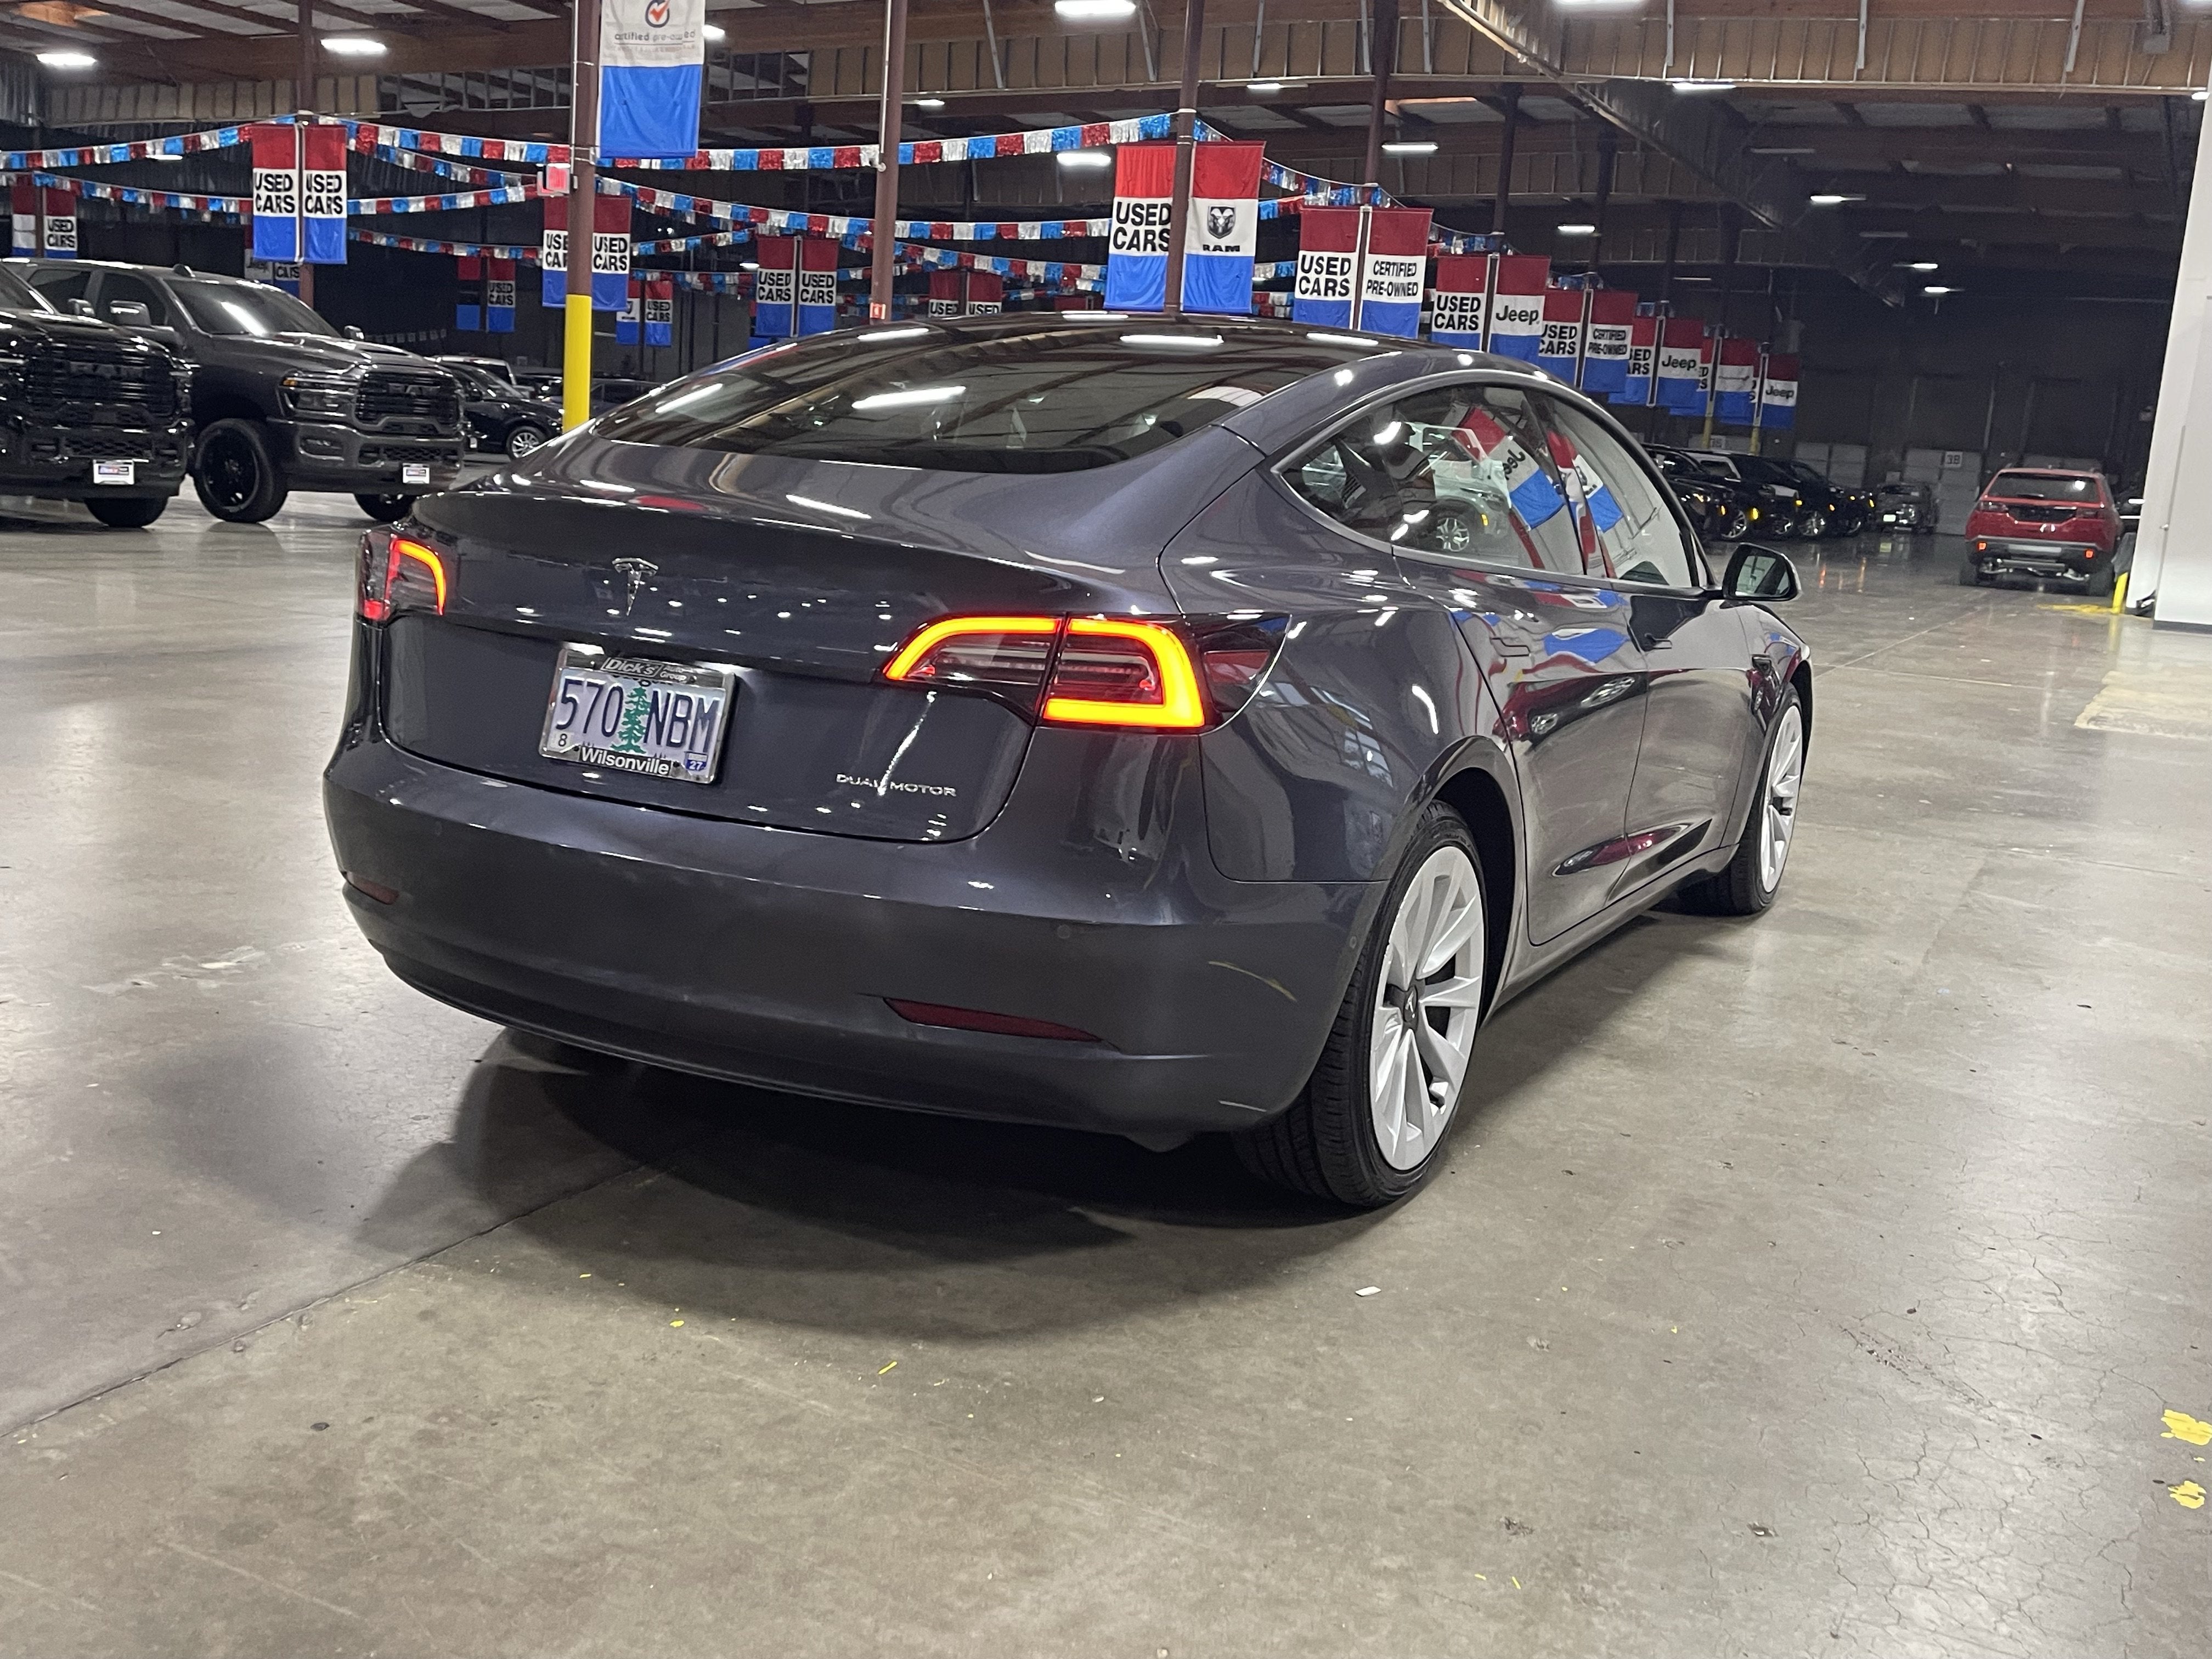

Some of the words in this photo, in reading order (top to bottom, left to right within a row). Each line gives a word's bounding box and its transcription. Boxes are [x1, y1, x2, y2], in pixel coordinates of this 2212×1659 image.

[254, 172, 293, 192] USED
[306, 173, 342, 193] USED
[255, 193, 295, 213] CARS
[305, 195, 343, 215] CARS
[1116, 201, 1172, 226] USED
[546, 234, 568, 250] USE
[595, 236, 628, 253] USED
[1113, 227, 1171, 251] CARS
[594, 254, 627, 271] CARS
[1300, 255, 1351, 276] USED
[1373, 260, 1417, 277] CERTIFIED
[759, 271, 791, 286] USED
[802, 273, 834, 288] USED
[1299, 275, 1350, 297] CARS
[758, 286, 791, 301] CARS
[800, 289, 833, 303] CARS
[1365, 279, 1418, 297] PRE-OWNED
[1437, 295, 1481, 312] USED
[1434, 313, 1479, 330] CARS
[1496, 305, 1539, 325] Jeep
[1662, 356, 1696, 370] Jeep
[1766, 386, 1794, 399] Jeep
[606, 659, 655, 675] Dick's
[660, 671, 687, 681] Group
[556, 678, 624, 737] 570
[643, 690, 721, 753] NBM
[558, 733, 567, 747] 8
[582, 746, 669, 775] Wilsonville
[689, 761, 702, 770] 27
[890, 781, 956, 797] MOTOR
